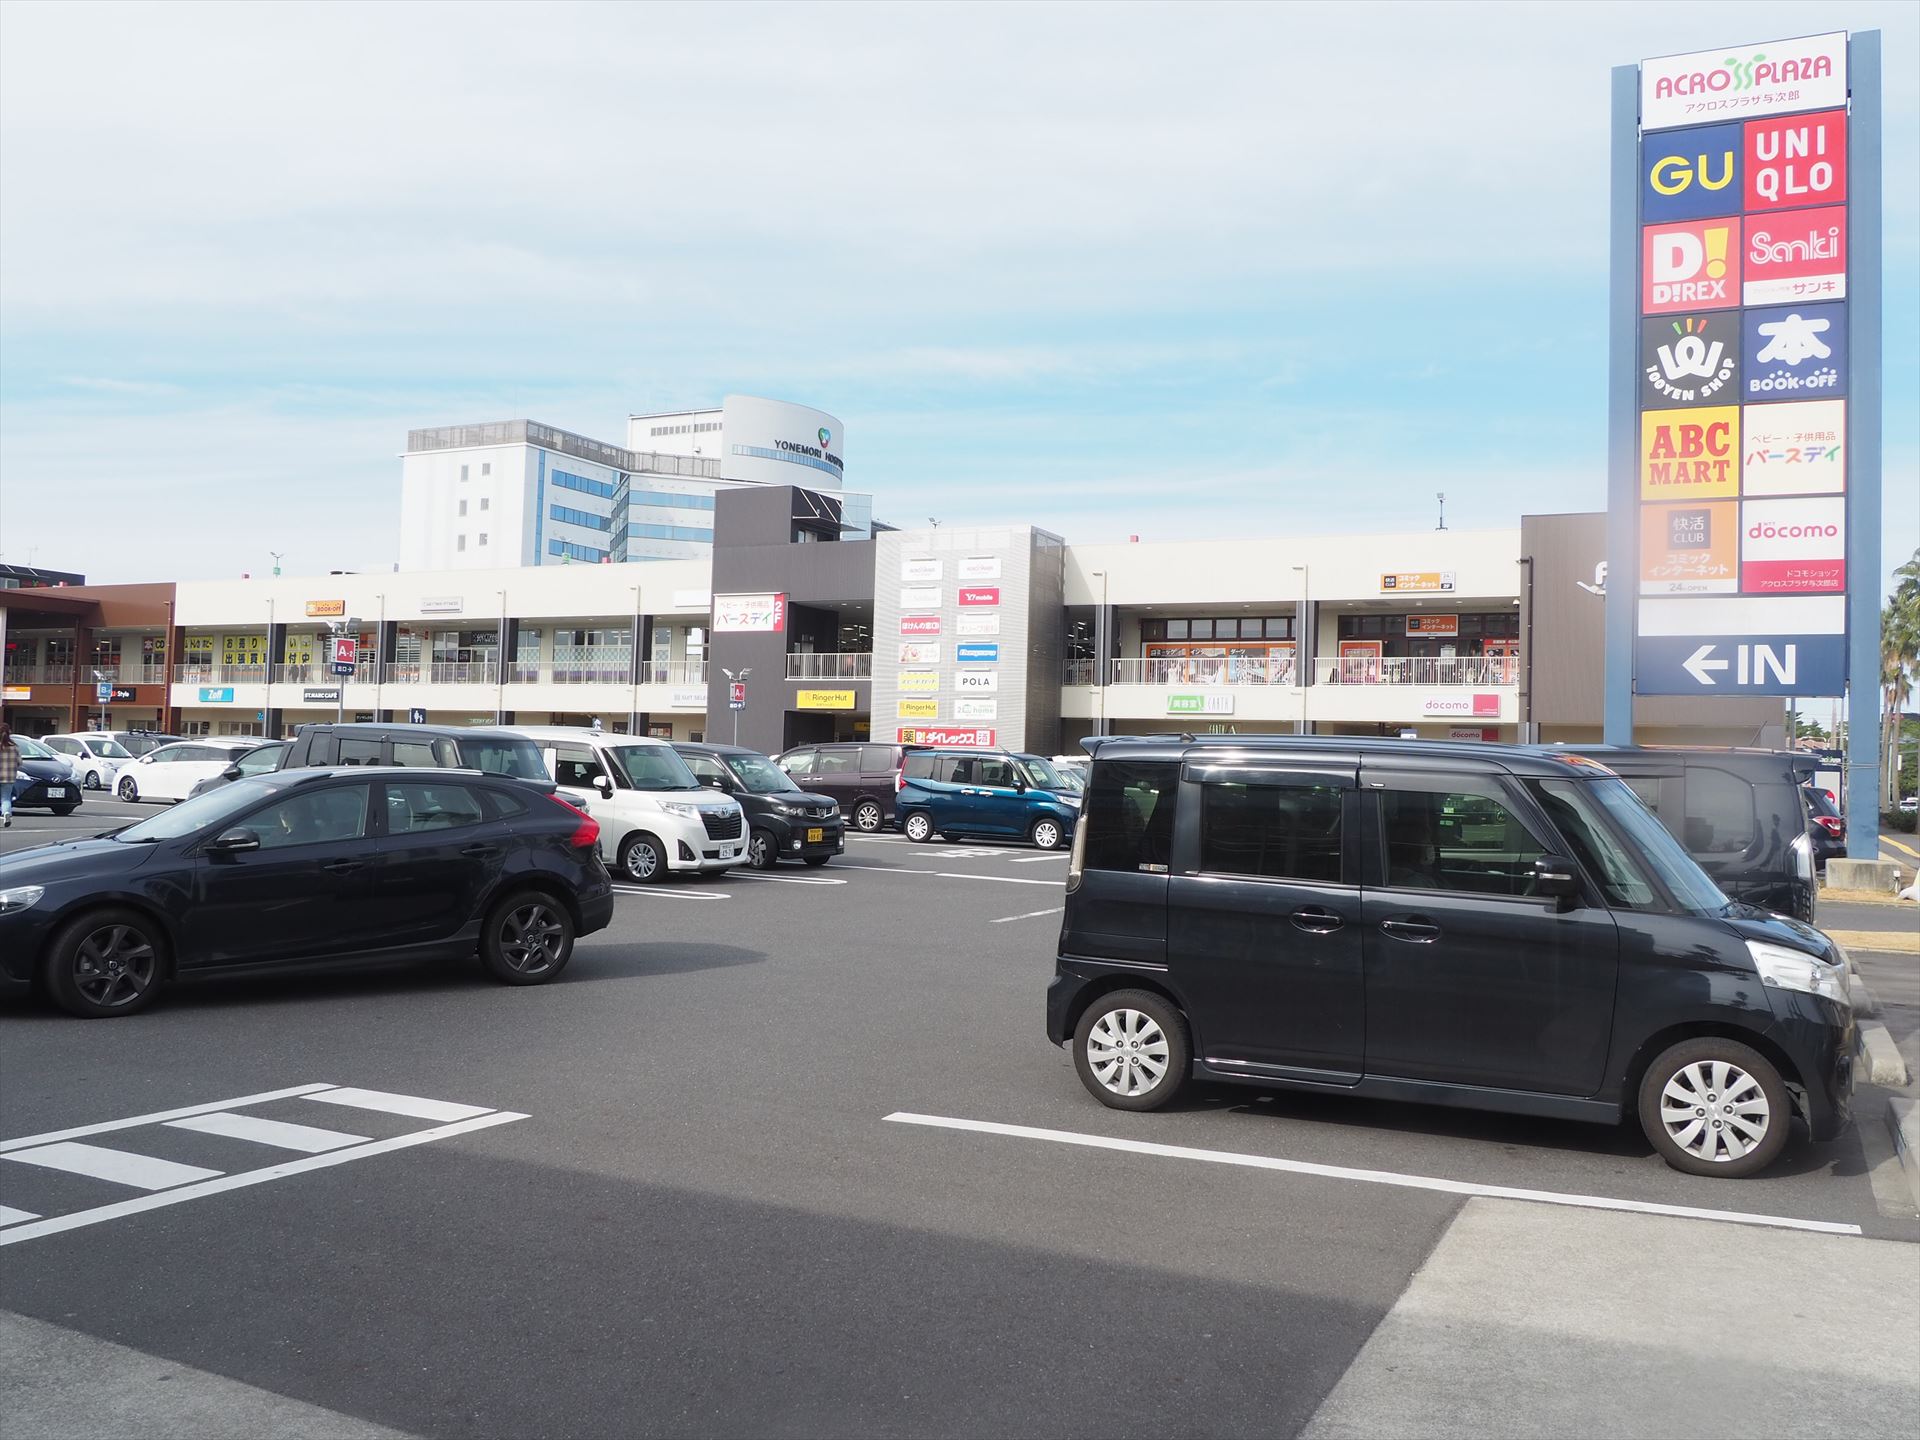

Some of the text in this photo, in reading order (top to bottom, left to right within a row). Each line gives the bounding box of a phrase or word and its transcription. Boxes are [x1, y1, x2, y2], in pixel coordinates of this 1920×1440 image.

[1685, 90, 1800, 113] アクロスプラザ与次郎
[1756, 125, 1825, 161] UNI
[1650, 152, 1733, 195] GU
[1756, 161, 1833, 201] QLO
[1750, 226, 1839, 265] Sanki
[1793, 280, 1836, 295] サンキ
[1701, 358, 1736, 398] SHOP
[774, 440, 822, 458] YONEMORI
[1650, 422, 1730, 459] ABC
[1746, 445, 1841, 466] バースデイ
[1649, 460, 1730, 485] MART
[1672, 516, 1704, 531] 快活
[1748, 522, 1838, 539] docomo
[1673, 533, 1704, 544] CLUB
[1666, 553, 1712, 564] コミック
[1649, 564, 1729, 576] インターネット
[716, 612, 772, 625] バースデイ
[1737, 644, 1796, 685] IN
[962, 678, 990, 686] POLA
[208, 689, 223, 699] Zoff
[812, 694, 834, 702] Ringer
[1425, 700, 1469, 710] docomo
[926, 732, 976, 744] ダイレックス
